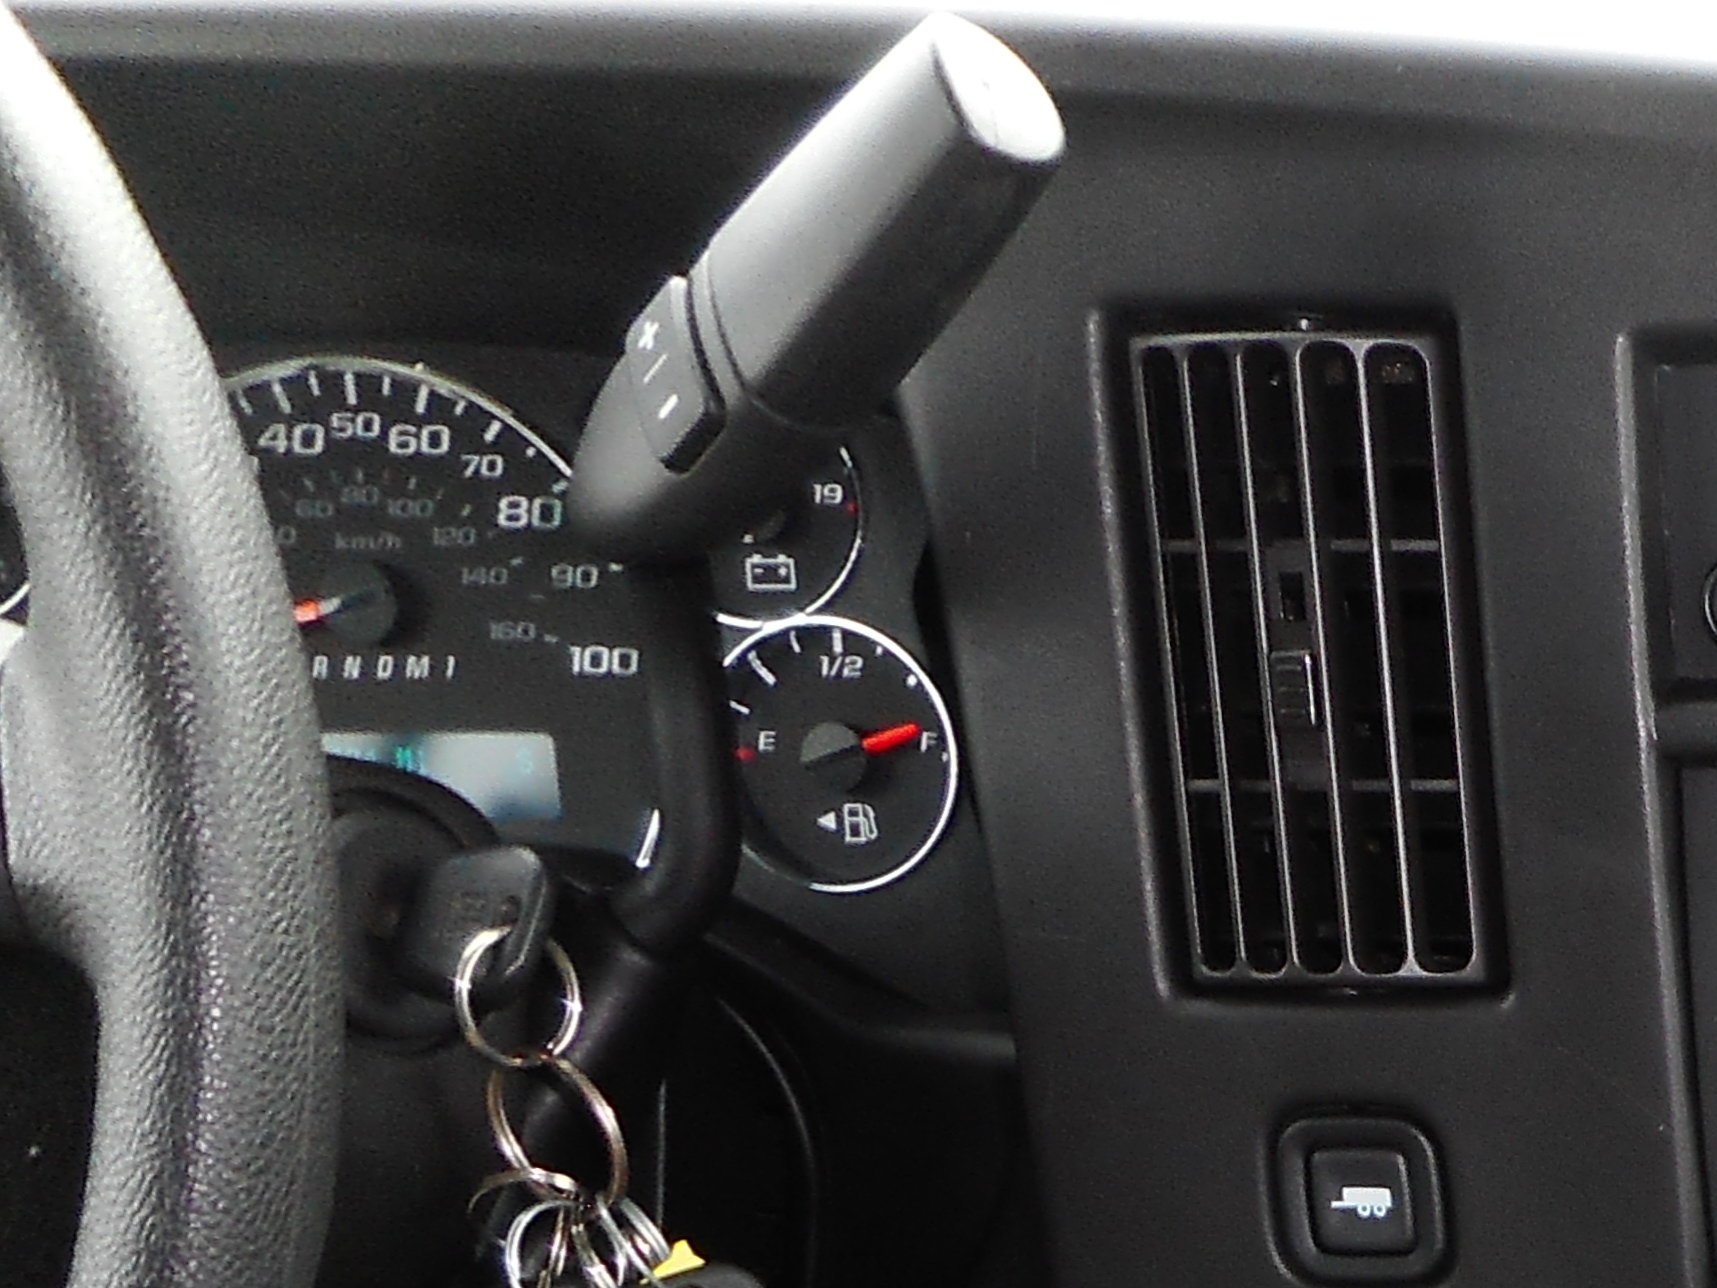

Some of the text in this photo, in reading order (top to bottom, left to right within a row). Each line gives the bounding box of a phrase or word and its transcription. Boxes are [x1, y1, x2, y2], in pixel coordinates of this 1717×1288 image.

[329, 411, 382, 439] 50
[257, 422, 325, 456] 40
[387, 424, 451, 456] 60
[460, 454, 505, 479] 70
[813, 483, 844, 505] 19
[497, 495, 564, 530] 80
[334, 531, 401, 551] km/h
[433, 526, 477, 547] 120
[461, 566, 508, 587] 140
[550, 563, 600, 590] 90
[489, 621, 537, 642] 160
[568, 645, 641, 677] 100
[818, 655, 865, 679] 1/2
[757, 730, 776, 752] E
[919, 730, 938, 753] F
